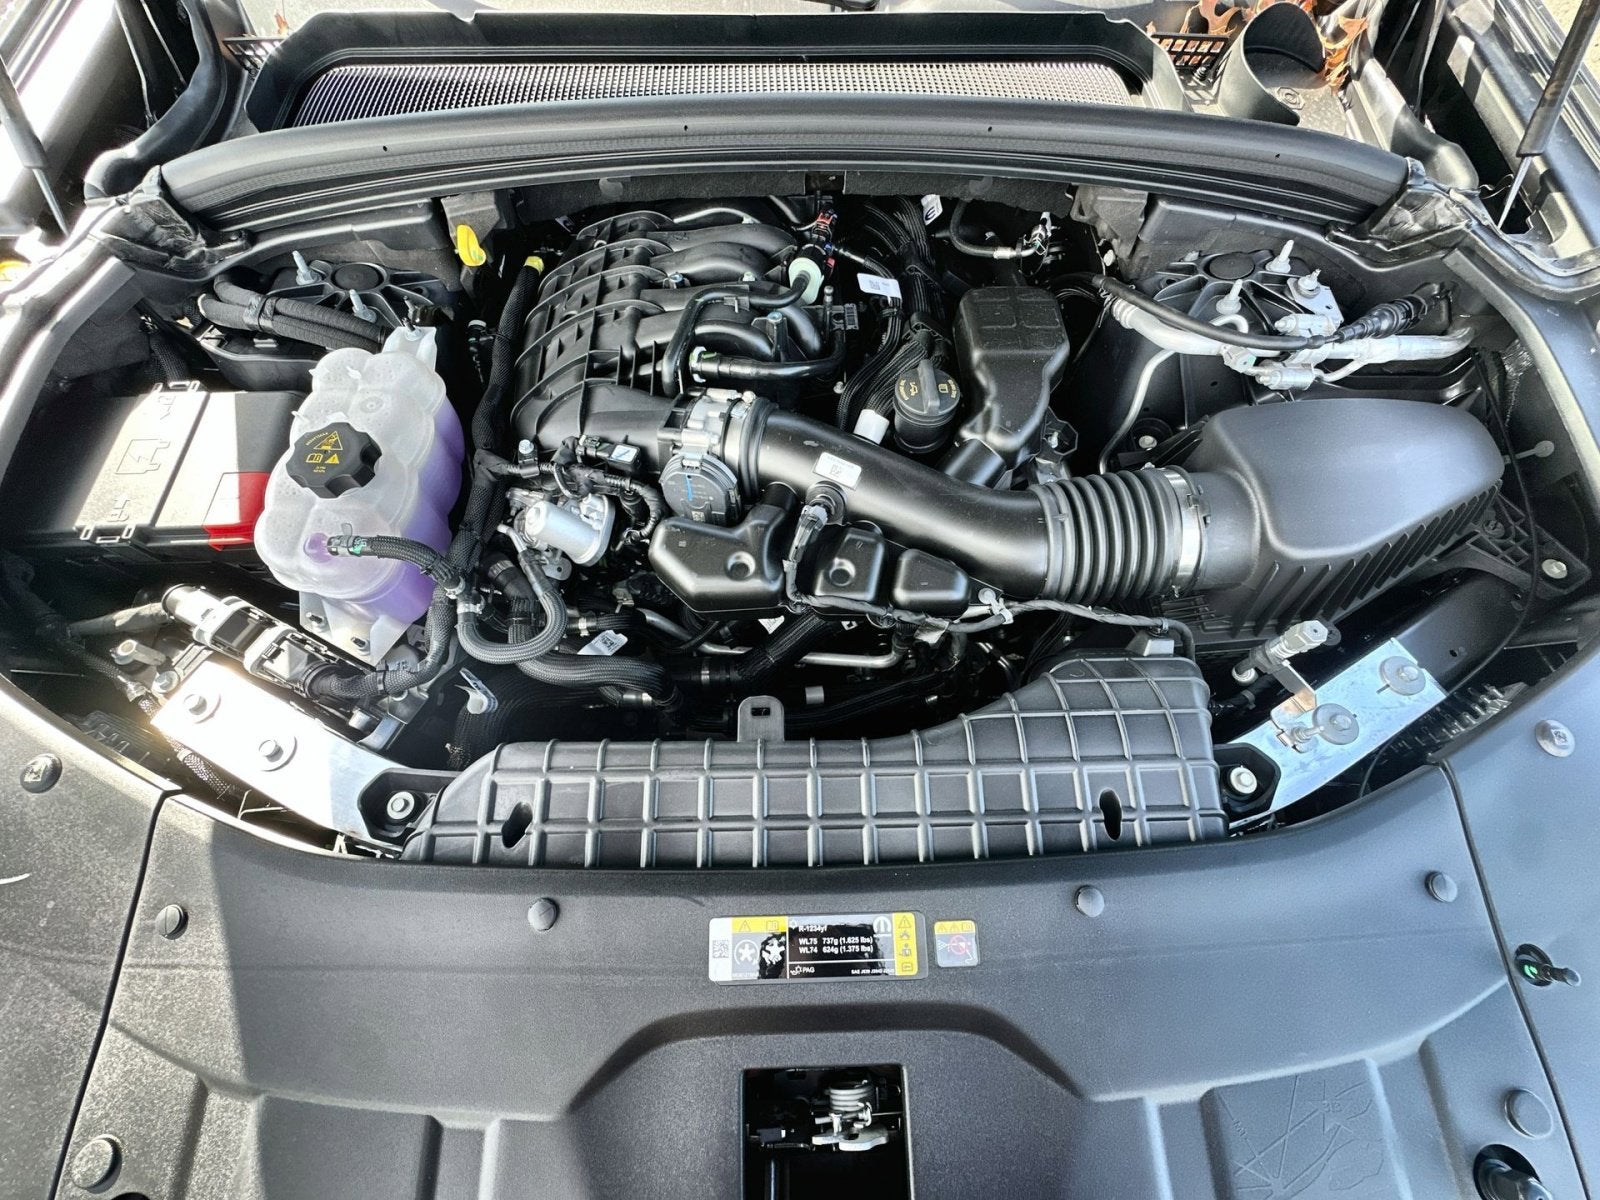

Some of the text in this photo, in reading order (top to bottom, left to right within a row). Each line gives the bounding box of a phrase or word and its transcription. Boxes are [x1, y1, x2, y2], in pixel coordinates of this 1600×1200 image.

[798, 925, 828, 934] R-1234yf
[798, 937, 818, 945] WL75
[822, 937, 838, 946] 737g
[860, 936, 873, 944] lbs)
[799, 944, 873, 954] WL74 624g (1.375 lbs)
[802, 966, 815, 974] PAG
